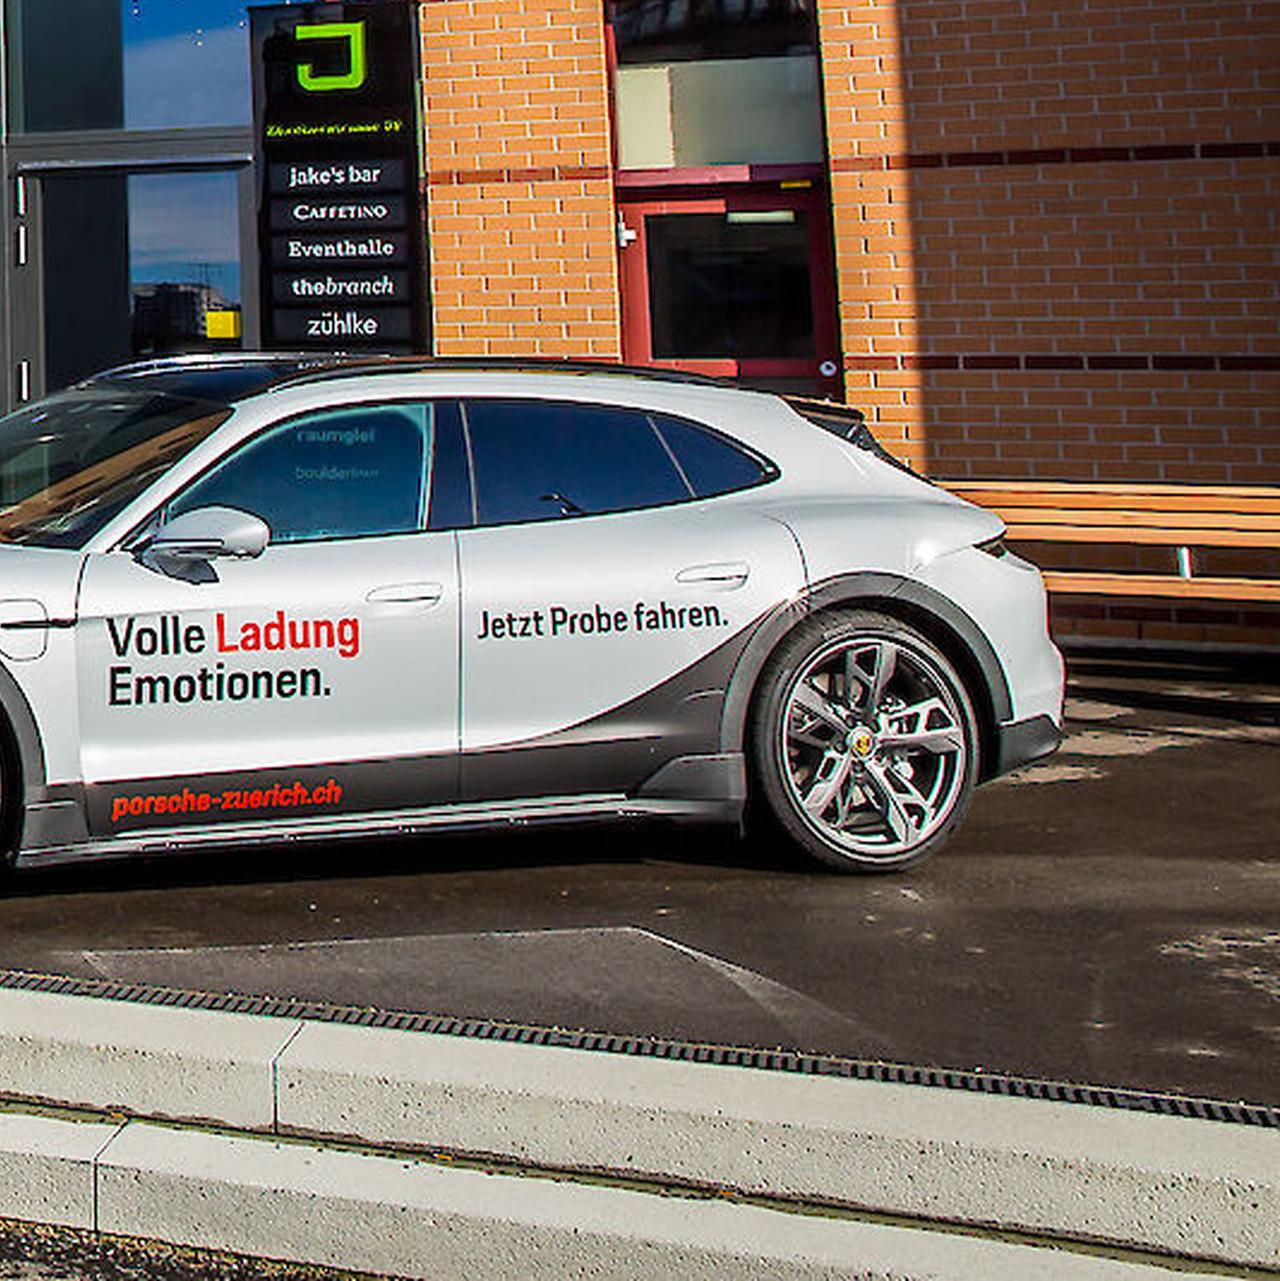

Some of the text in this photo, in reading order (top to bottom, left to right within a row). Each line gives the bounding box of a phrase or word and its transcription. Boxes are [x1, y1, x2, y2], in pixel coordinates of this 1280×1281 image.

[289, 166, 381, 187] jake's bar
[288, 239, 394, 257] Eventhalle
[291, 275, 394, 295] thebranch
[307, 311, 378, 335] zühlke
[106, 611, 358, 658] Volle Ladung
[478, 601, 729, 639] Jetzt Probe fahren.
[109, 663, 331, 705] Emotionen.
[112, 779, 342, 821] porsche-zuerich.ch
